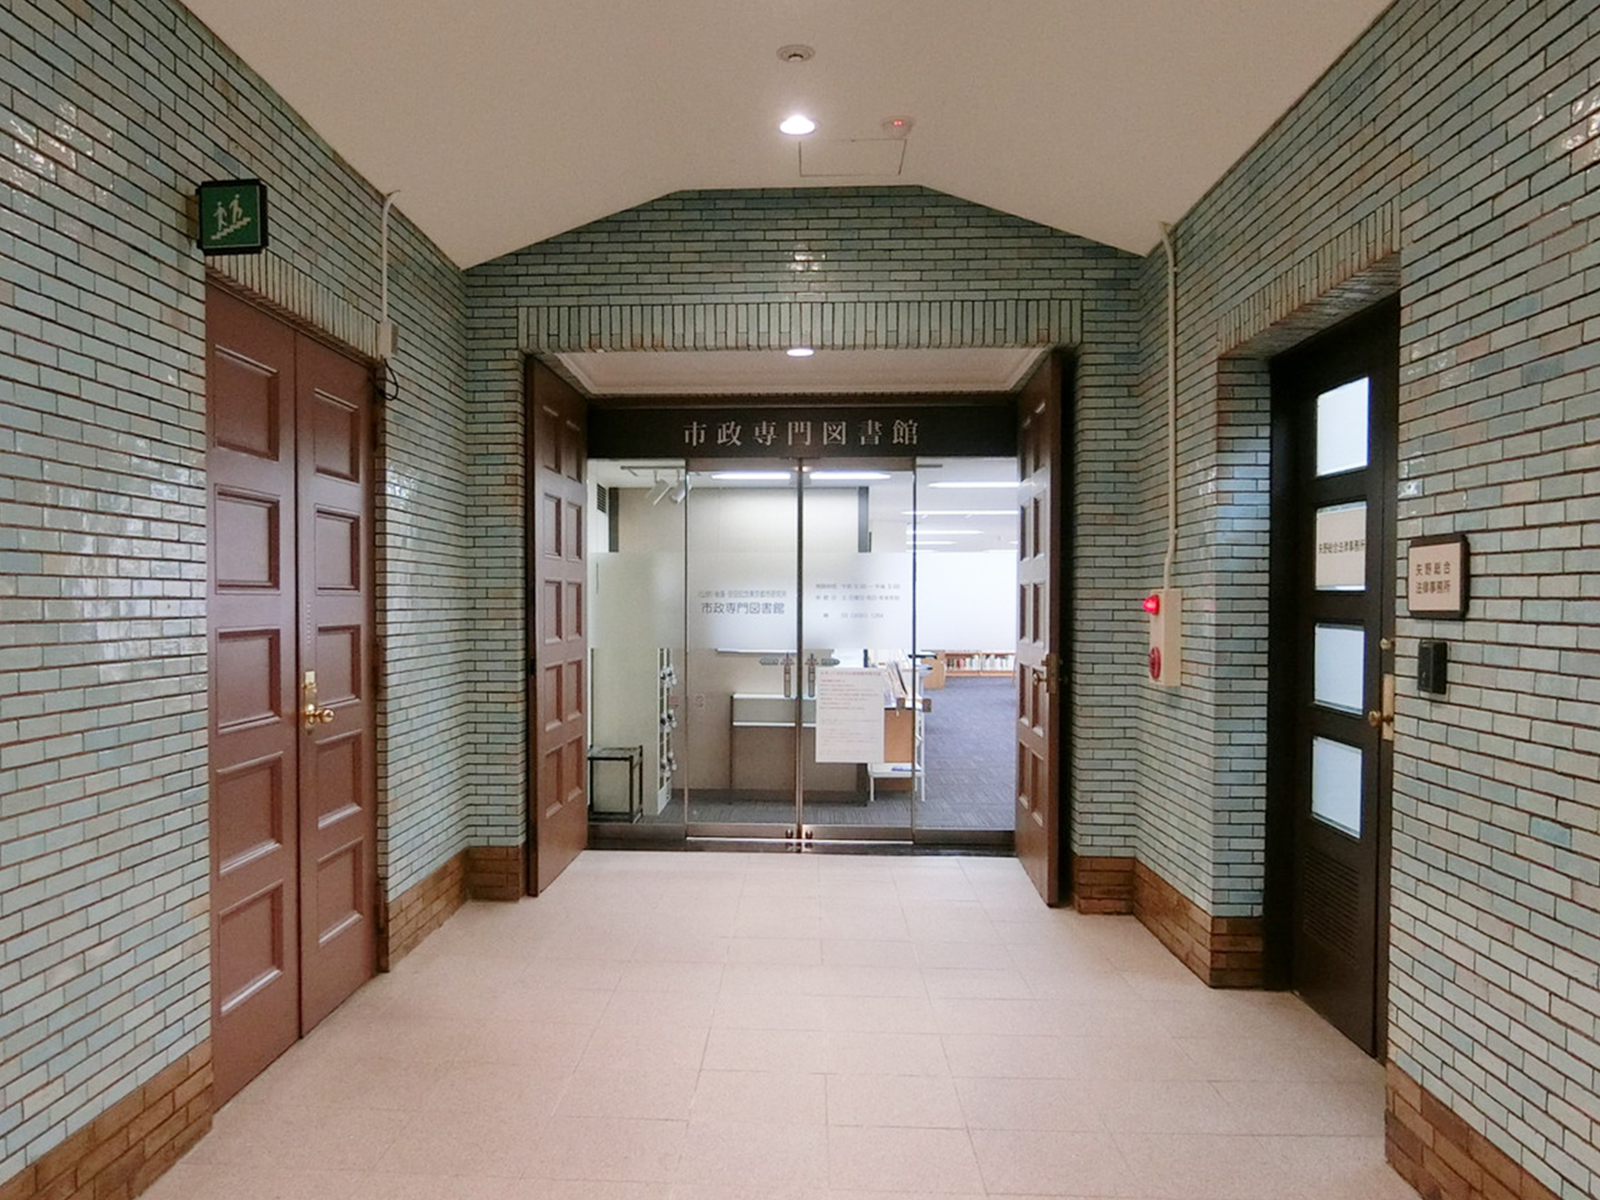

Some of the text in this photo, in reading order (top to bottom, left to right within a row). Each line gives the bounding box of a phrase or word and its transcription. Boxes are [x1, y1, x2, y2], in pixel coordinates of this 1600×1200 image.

[684, 419, 918, 447] 市政専門図書館
[701, 602, 785, 614] 市政専門図書館
